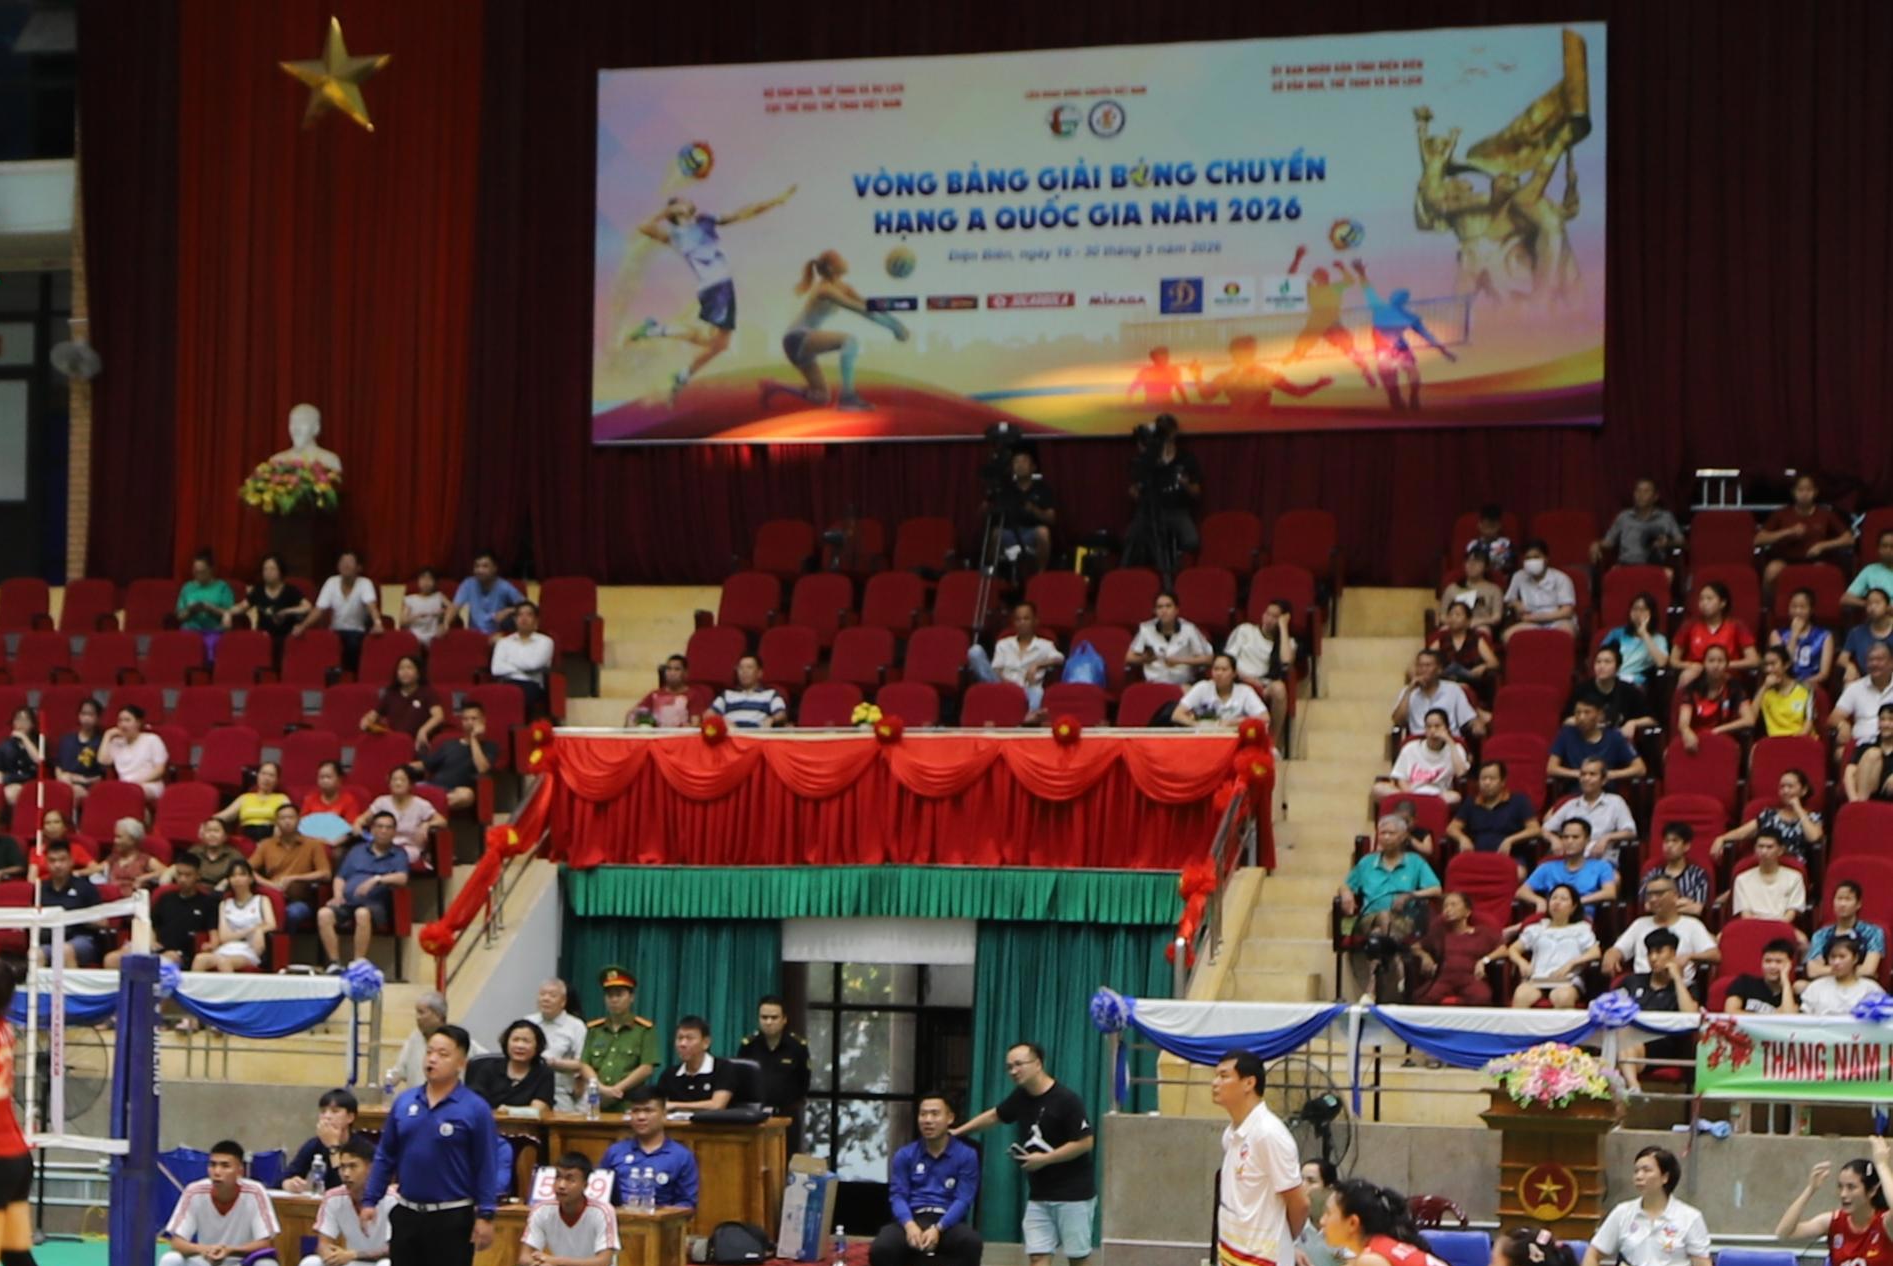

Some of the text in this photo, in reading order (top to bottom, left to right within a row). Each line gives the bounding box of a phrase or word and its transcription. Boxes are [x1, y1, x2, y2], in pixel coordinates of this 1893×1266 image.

[853, 167, 938, 197] VÒNG
[1037, 157, 1101, 191] GIẢI
[873, 193, 1303, 241] HẠNG A QUỐC GIA NĂM 2026
[1760, 1032, 1827, 1081] THÁNG
[1833, 1033, 1882, 1082] NĂM
